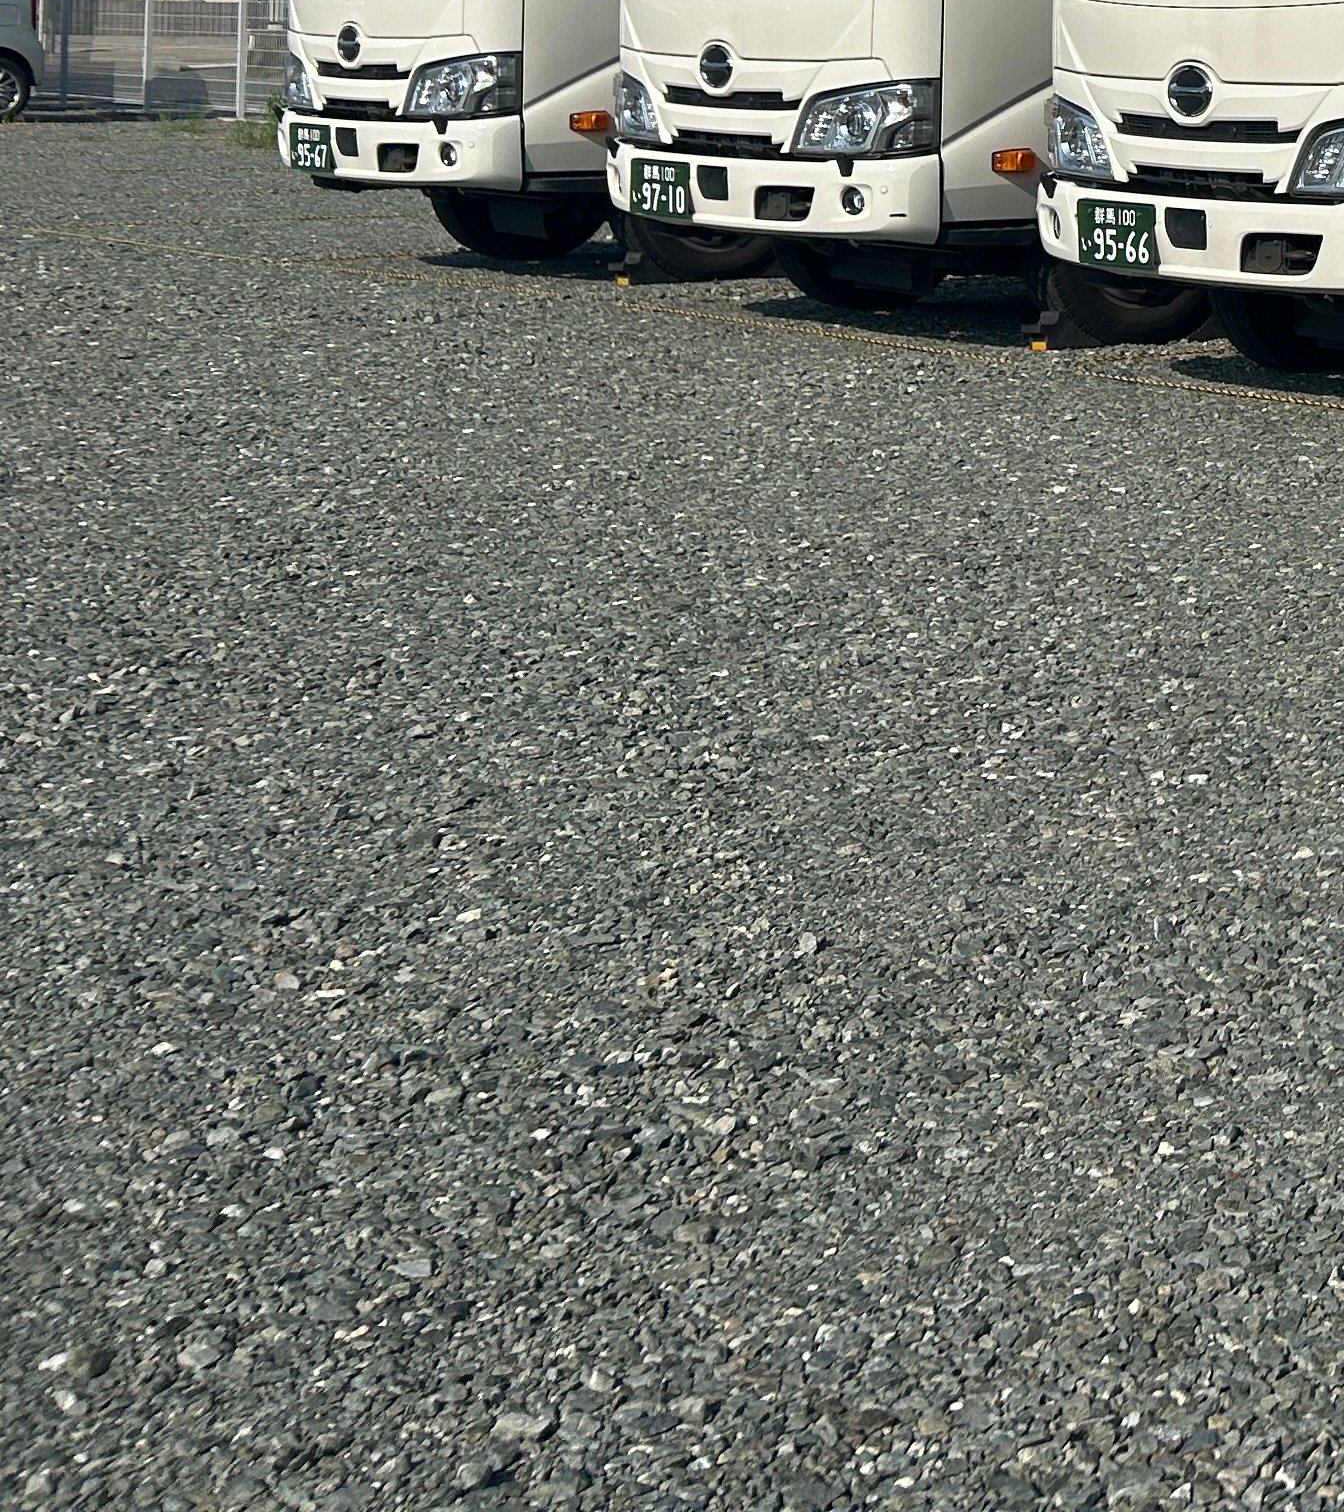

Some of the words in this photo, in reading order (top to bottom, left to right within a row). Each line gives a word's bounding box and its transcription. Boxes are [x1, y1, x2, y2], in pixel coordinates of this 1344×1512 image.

[297, 143, 327, 168] 95-67
[642, 182, 685, 214] 97-10
[1081, 236, 1092, 251] い
[1093, 228, 1149, 264] 95-66
